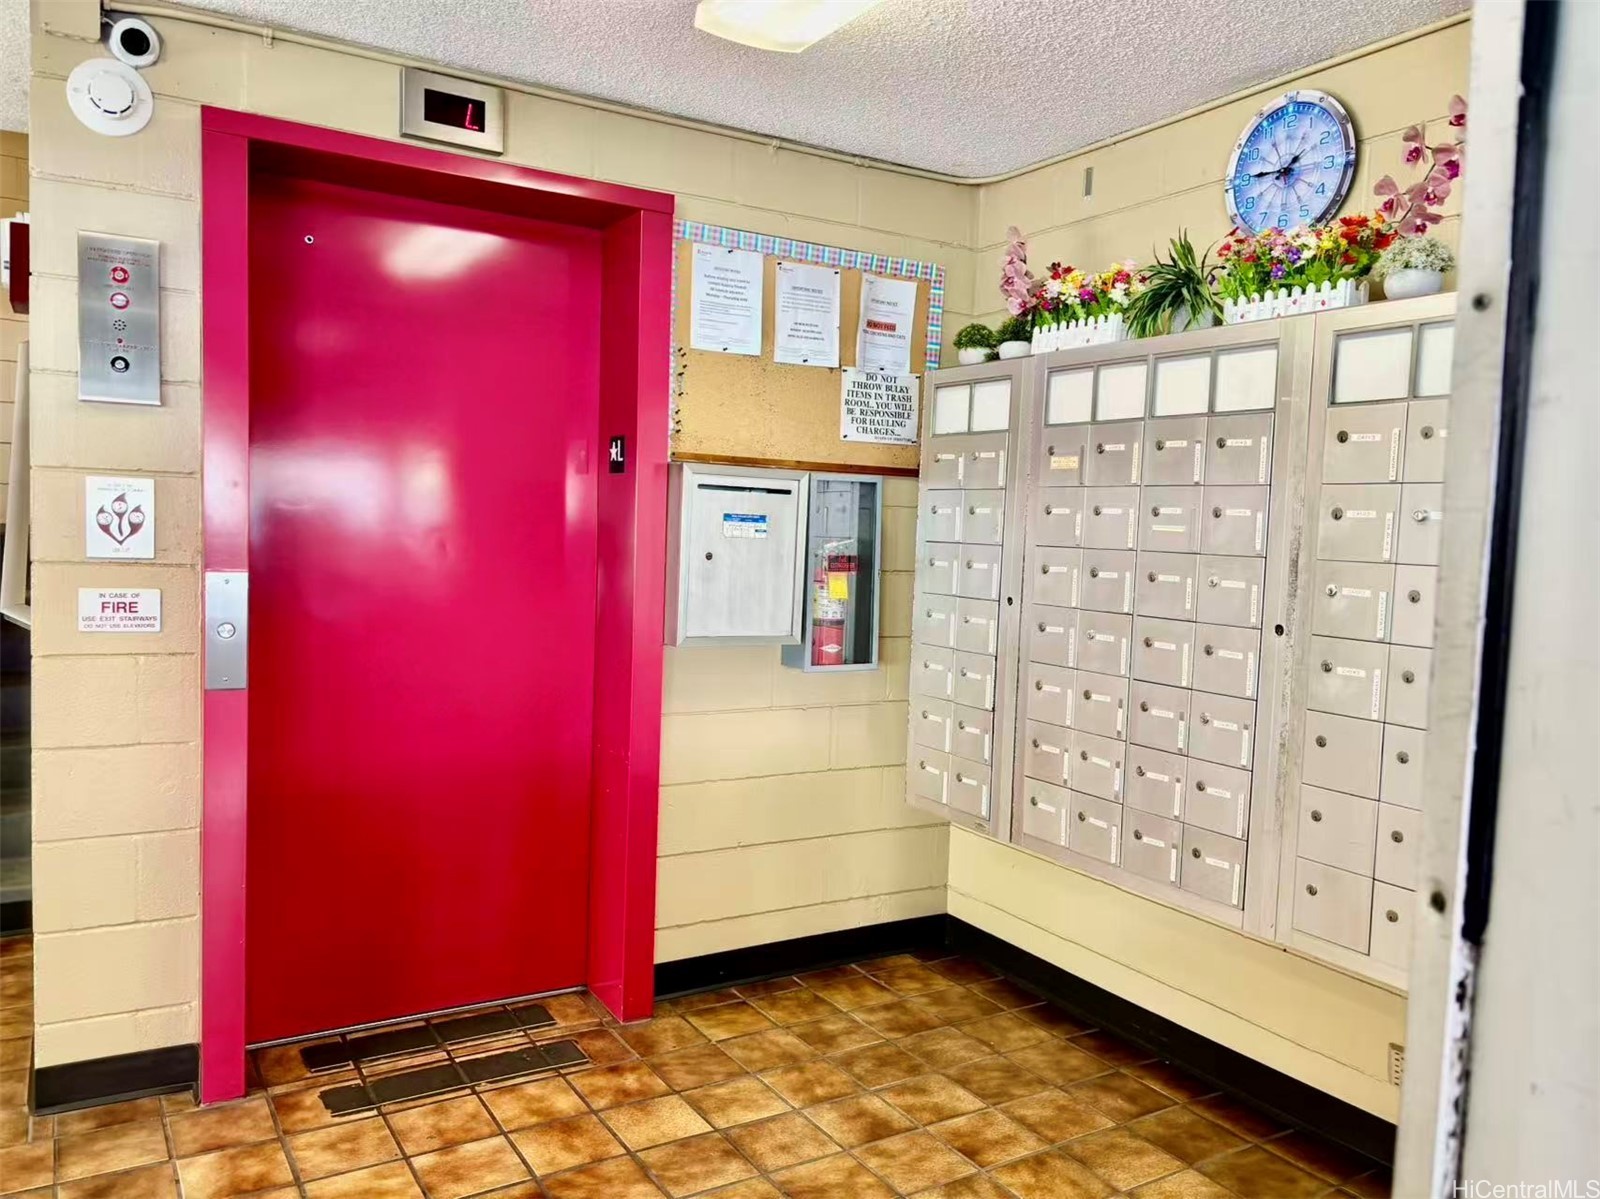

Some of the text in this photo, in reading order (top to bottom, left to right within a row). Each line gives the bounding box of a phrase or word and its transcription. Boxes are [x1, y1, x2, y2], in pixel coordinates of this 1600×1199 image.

[465, 103, 479, 130] L
[1282, 114, 1297, 129] 12
[1309, 116, 1313, 129] 1
[1264, 126, 1273, 140] 11
[1320, 130, 1331, 144] 2
[1248, 147, 1260, 161] 10
[1324, 155, 1335, 170] 3
[1242, 173, 1251, 187] 9
[1315, 182, 1326, 196] 4
[1246, 196, 1255, 210] 8
[1299, 204, 1310, 218] 5
[1259, 212, 1268, 225] 7
[1278, 214, 1288, 228] 6
[866, 373, 897, 384] DO NOT
[852, 381, 910, 394] THROW BULKY
[847, 390, 872, 399] ITEMS
[886, 394, 912, 403] TRASH
[876, 402, 892, 410] YOU
[894, 404, 914, 412] WILL
[860, 409, 912, 420] RESPONSIBLE
[851, 417, 906, 428] FOR HAULING
[101, 602, 139, 613] FIRE
